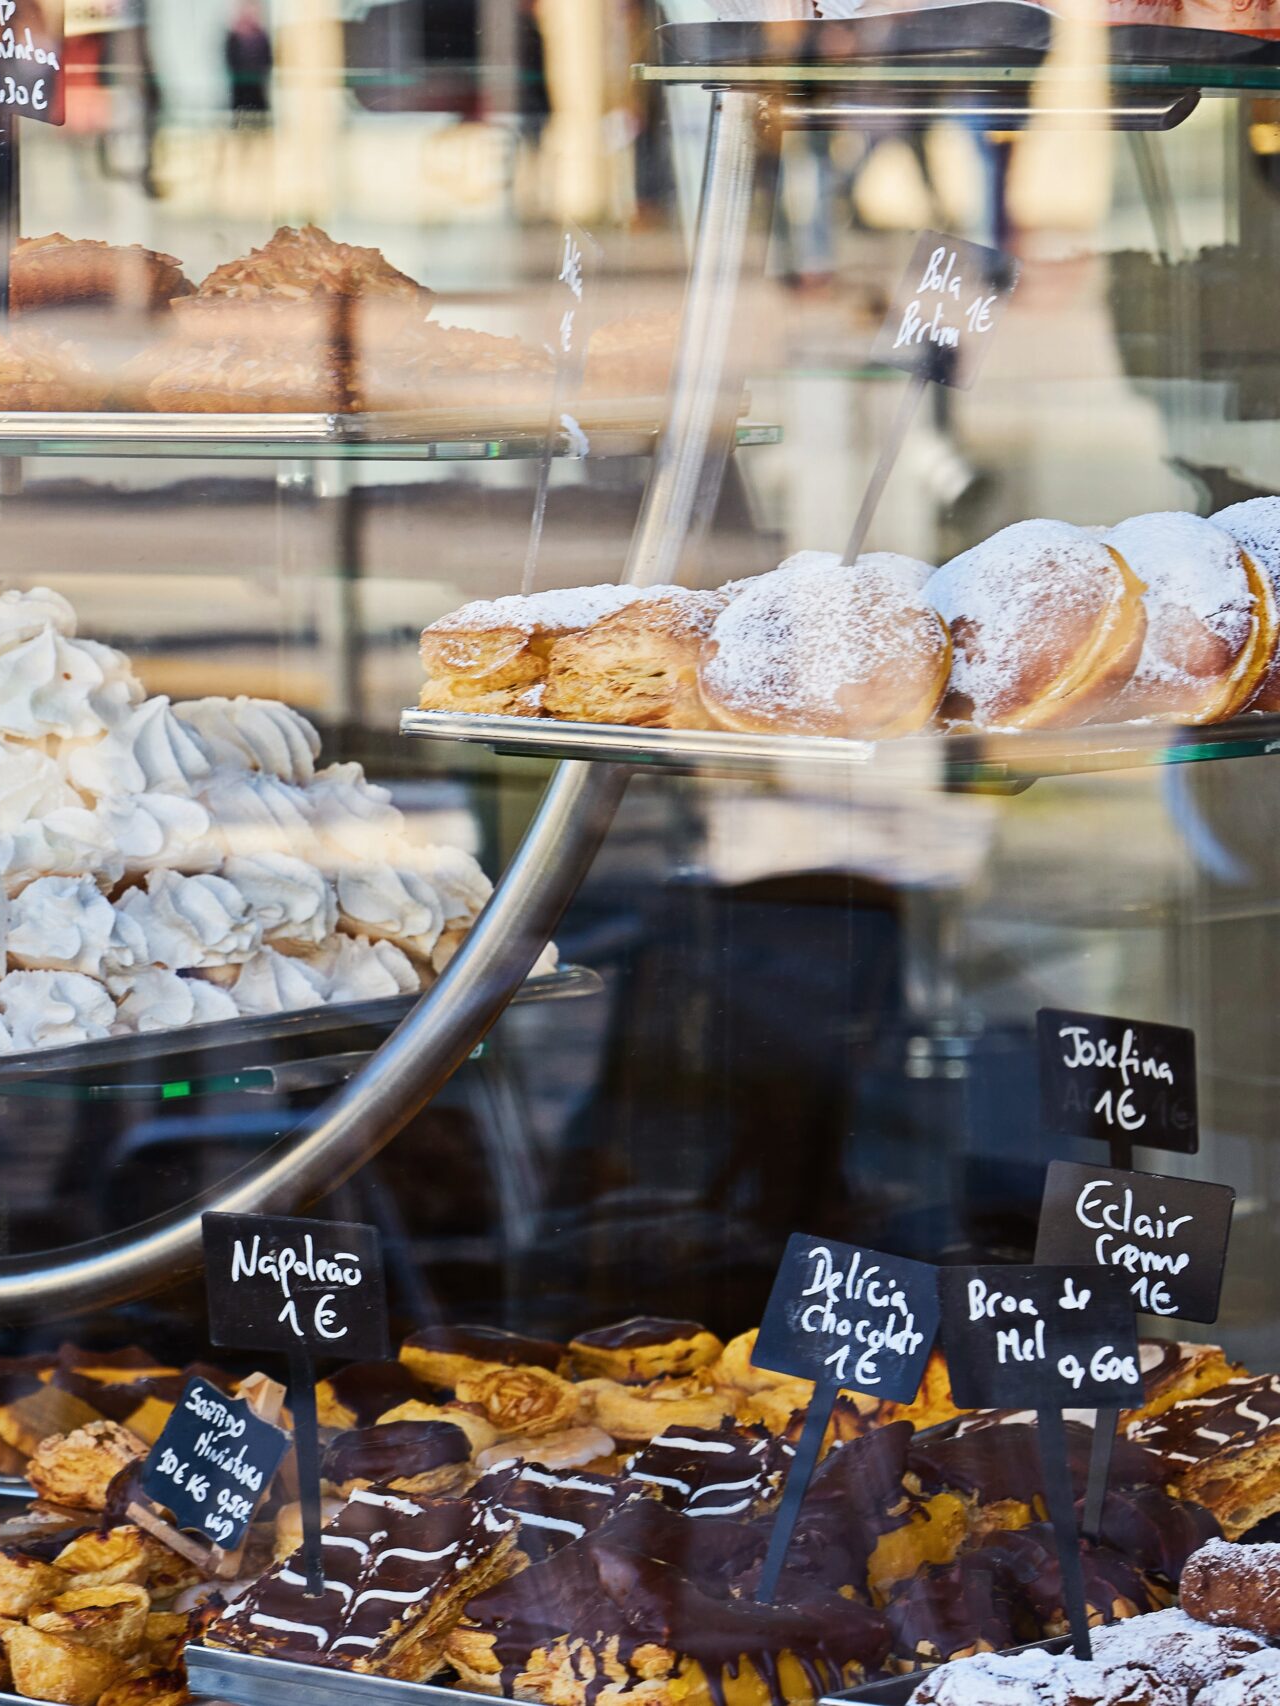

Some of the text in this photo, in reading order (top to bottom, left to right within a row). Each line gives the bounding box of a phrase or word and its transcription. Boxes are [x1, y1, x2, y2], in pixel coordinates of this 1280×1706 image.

[916, 246, 963, 301] Bola
[1057, 1025, 1174, 1087] Josefina
[1093, 1087, 1147, 1131] 1€
[1074, 1179, 1194, 1240] Eclair
[967, 1278, 1040, 1322] Broa
[1128, 1275, 1180, 1316] 1€
[995, 1318, 1047, 1365] Mel
[823, 1343, 882, 1386] 1€
